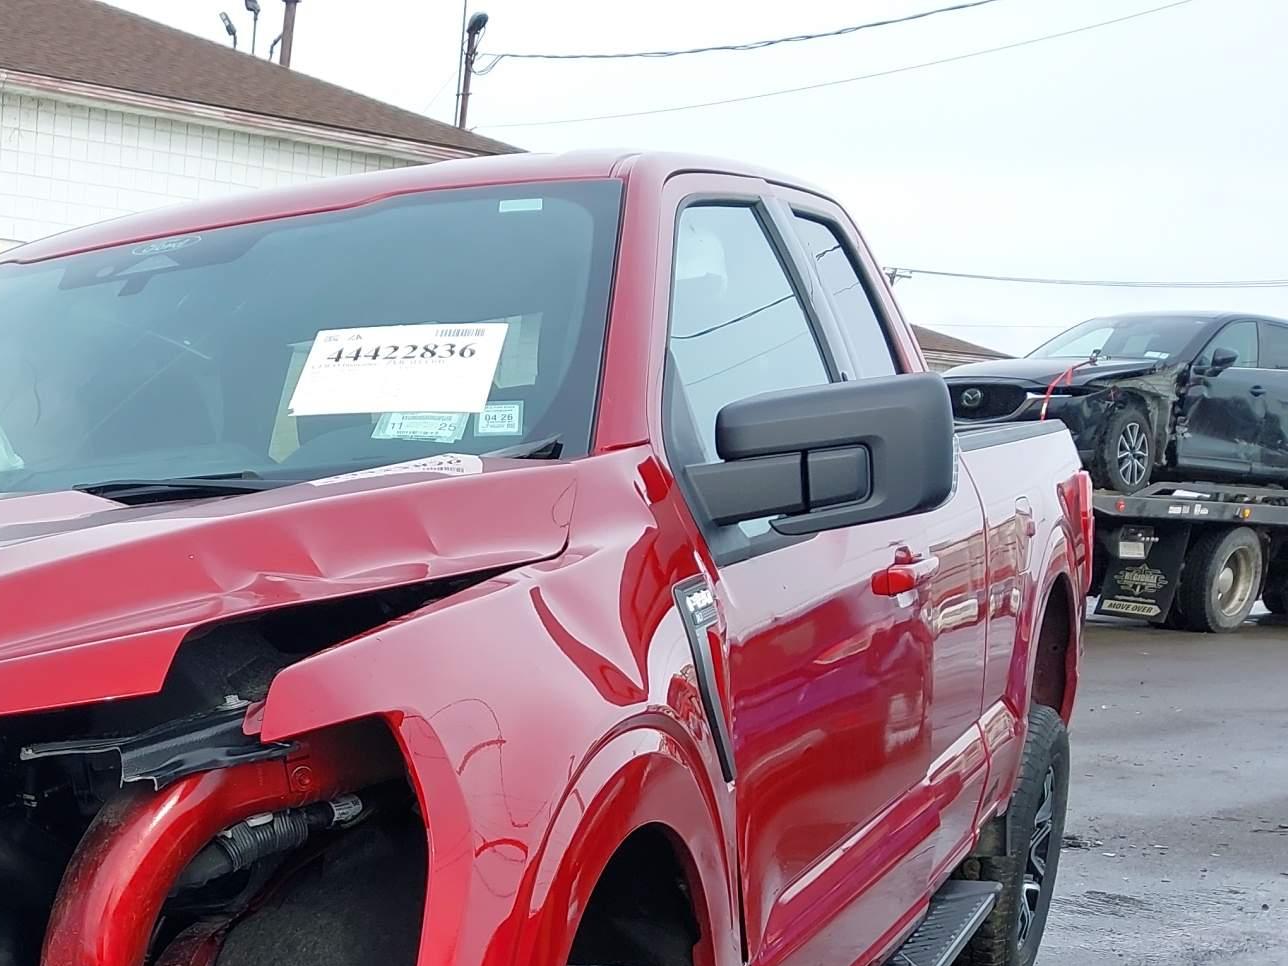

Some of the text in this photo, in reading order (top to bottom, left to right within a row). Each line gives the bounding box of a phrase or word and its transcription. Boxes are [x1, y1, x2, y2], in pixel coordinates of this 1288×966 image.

[326, 343, 478, 362] 44422836
[438, 422, 457, 431] 25
[1107, 601, 1154, 614] MOVE OVER
